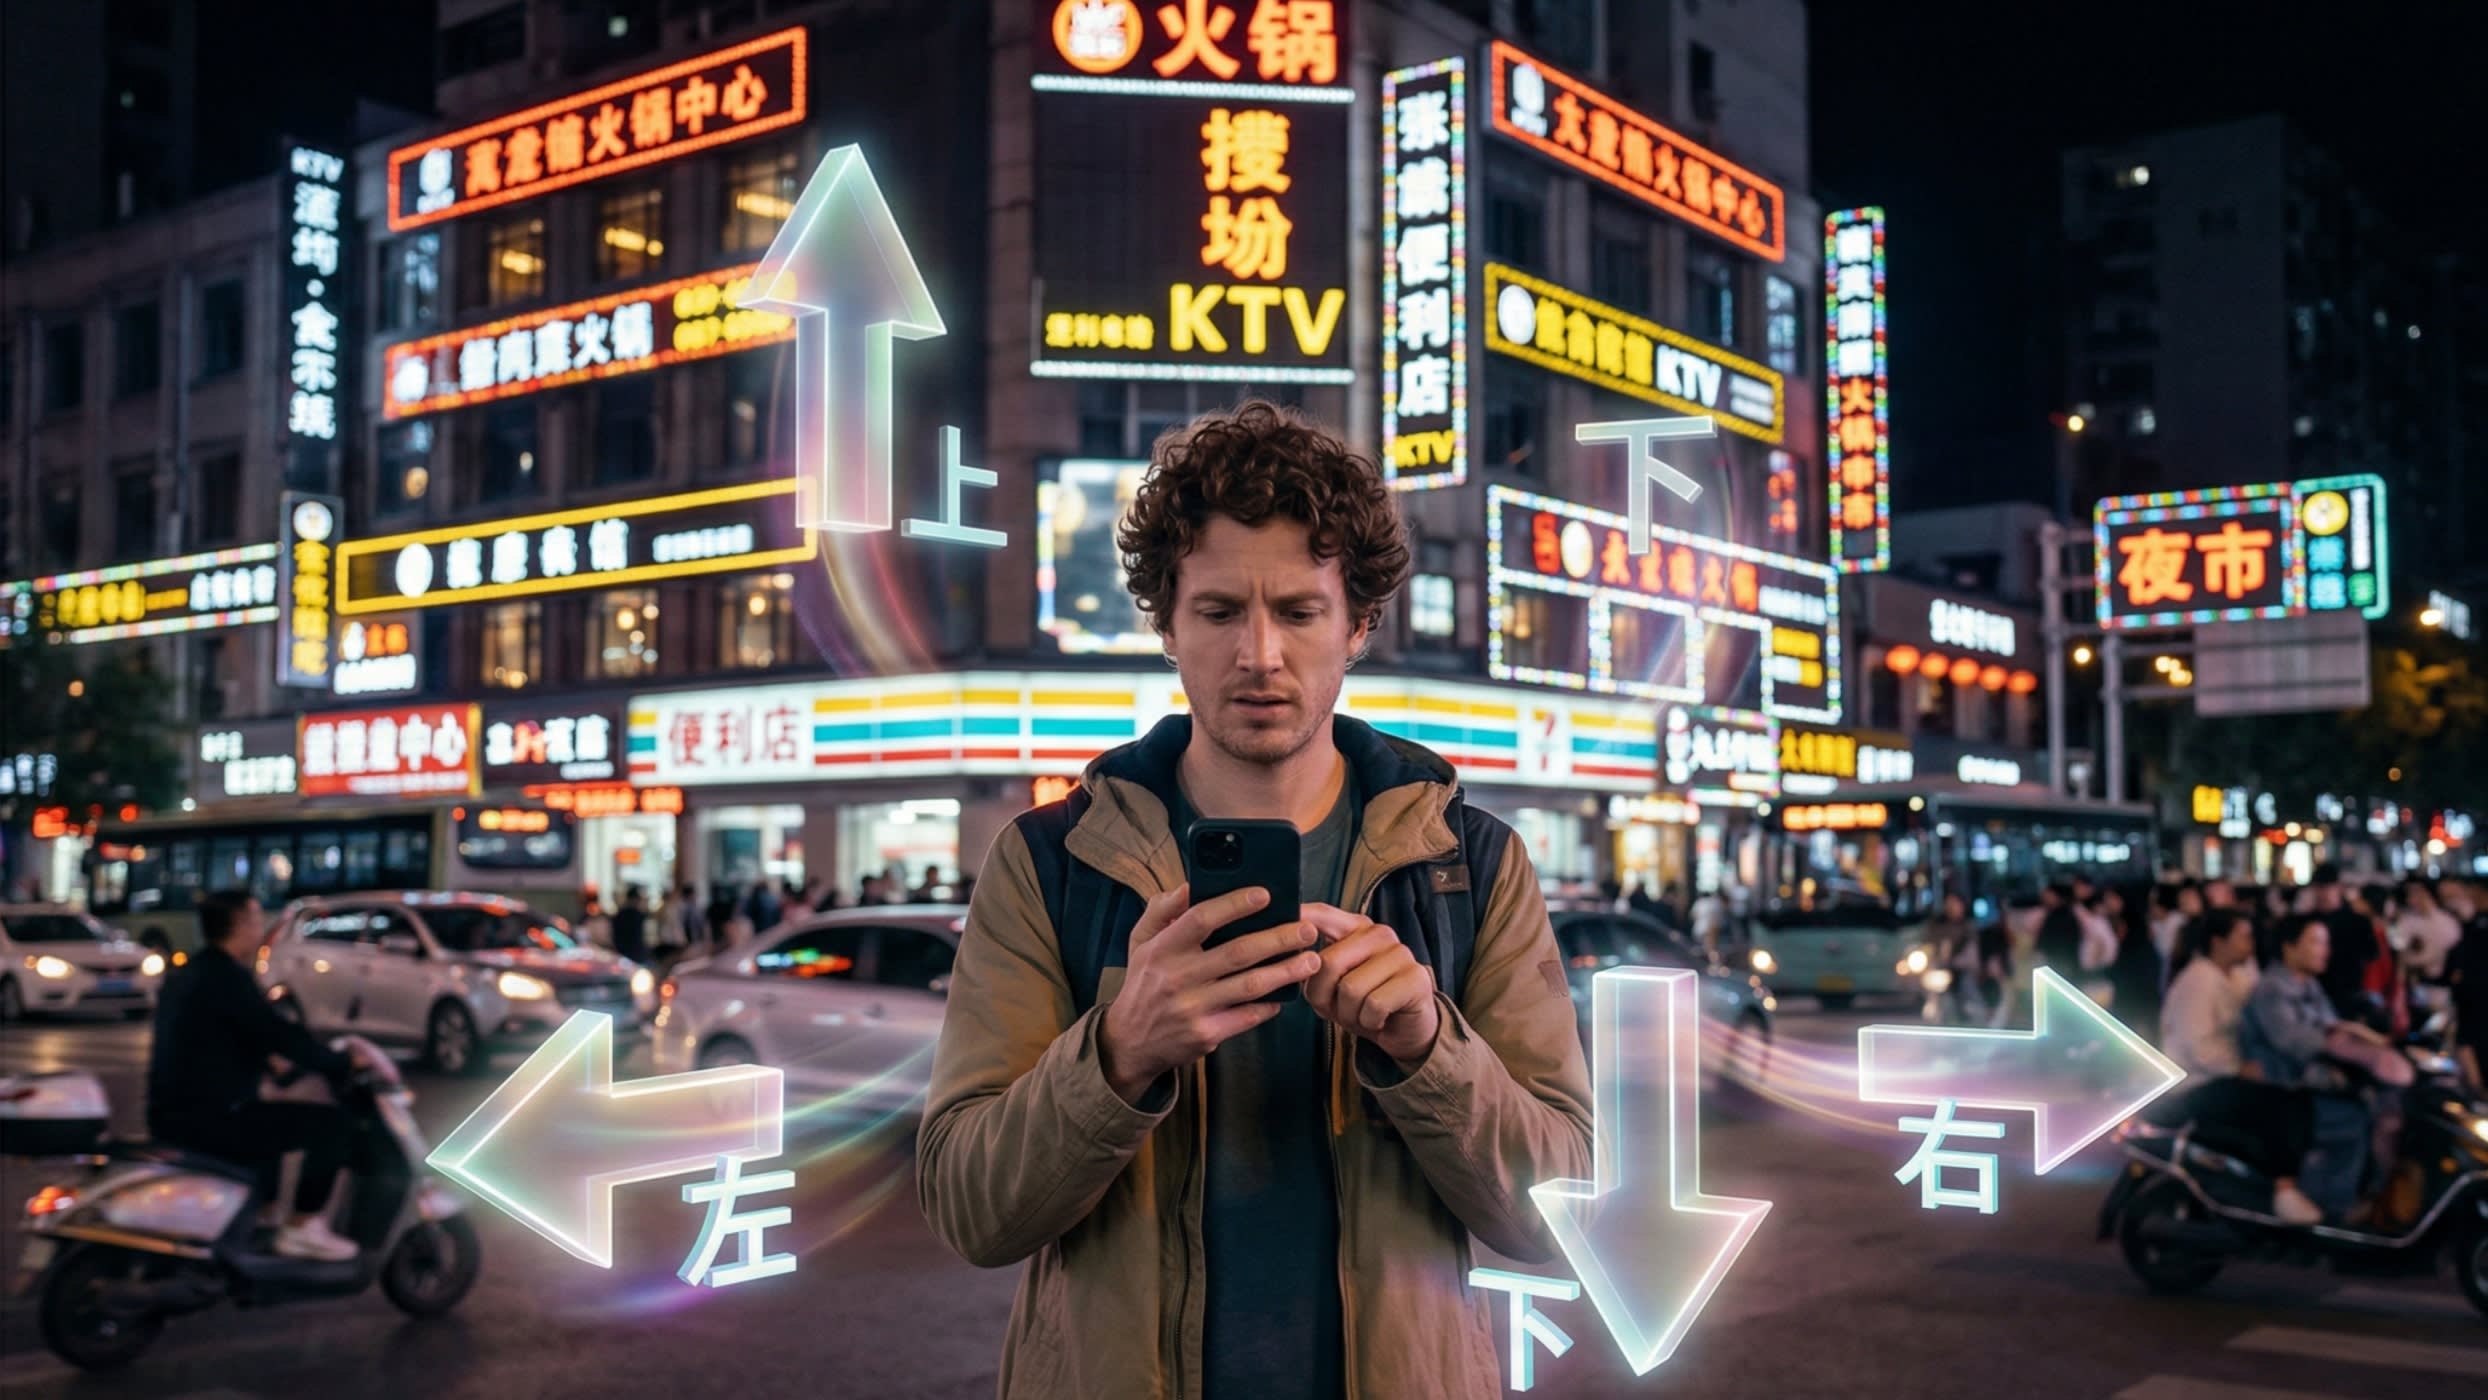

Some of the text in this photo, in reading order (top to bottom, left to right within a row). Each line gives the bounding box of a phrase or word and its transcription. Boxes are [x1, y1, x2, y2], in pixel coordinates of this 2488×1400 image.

[1152, 0, 1338, 83] 火锅
[1170, 284, 1346, 355] KTV
[1655, 345, 1722, 407] KTV
[1393, 430, 1457, 470] KTV
[2117, 520, 2273, 606] 夜市
[668, 703, 805, 769] 便利店
